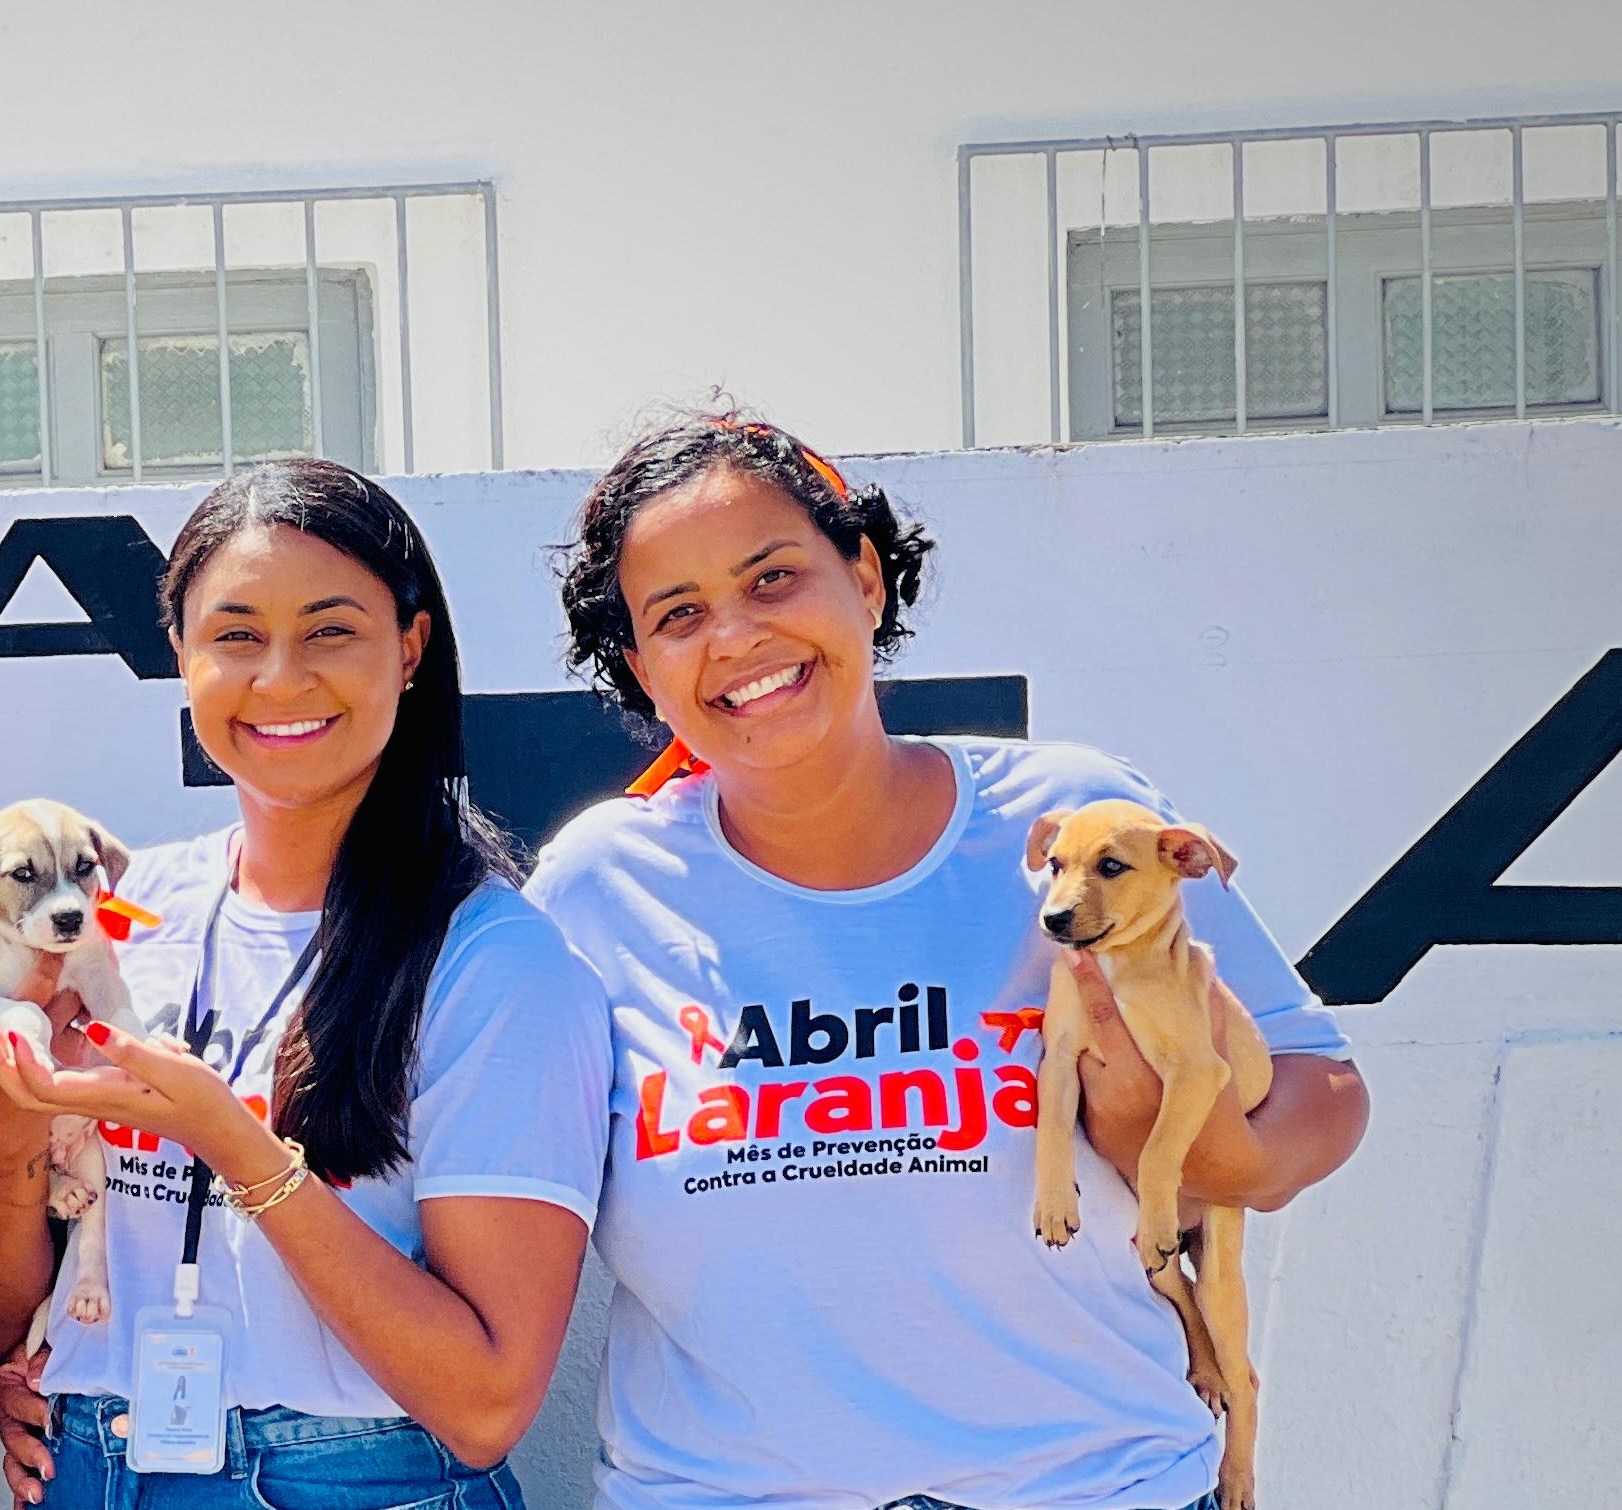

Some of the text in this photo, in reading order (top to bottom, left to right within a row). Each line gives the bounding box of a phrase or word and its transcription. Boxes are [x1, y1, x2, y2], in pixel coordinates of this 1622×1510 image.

[717, 983, 950, 1069] Abril
[636, 1039, 1038, 1161] Laranja
[728, 1133, 937, 1164] Mês de Prevenção
[153, 1160, 177, 1180] de
[684, 1155, 989, 1194] Contra a Crueldade Animal
